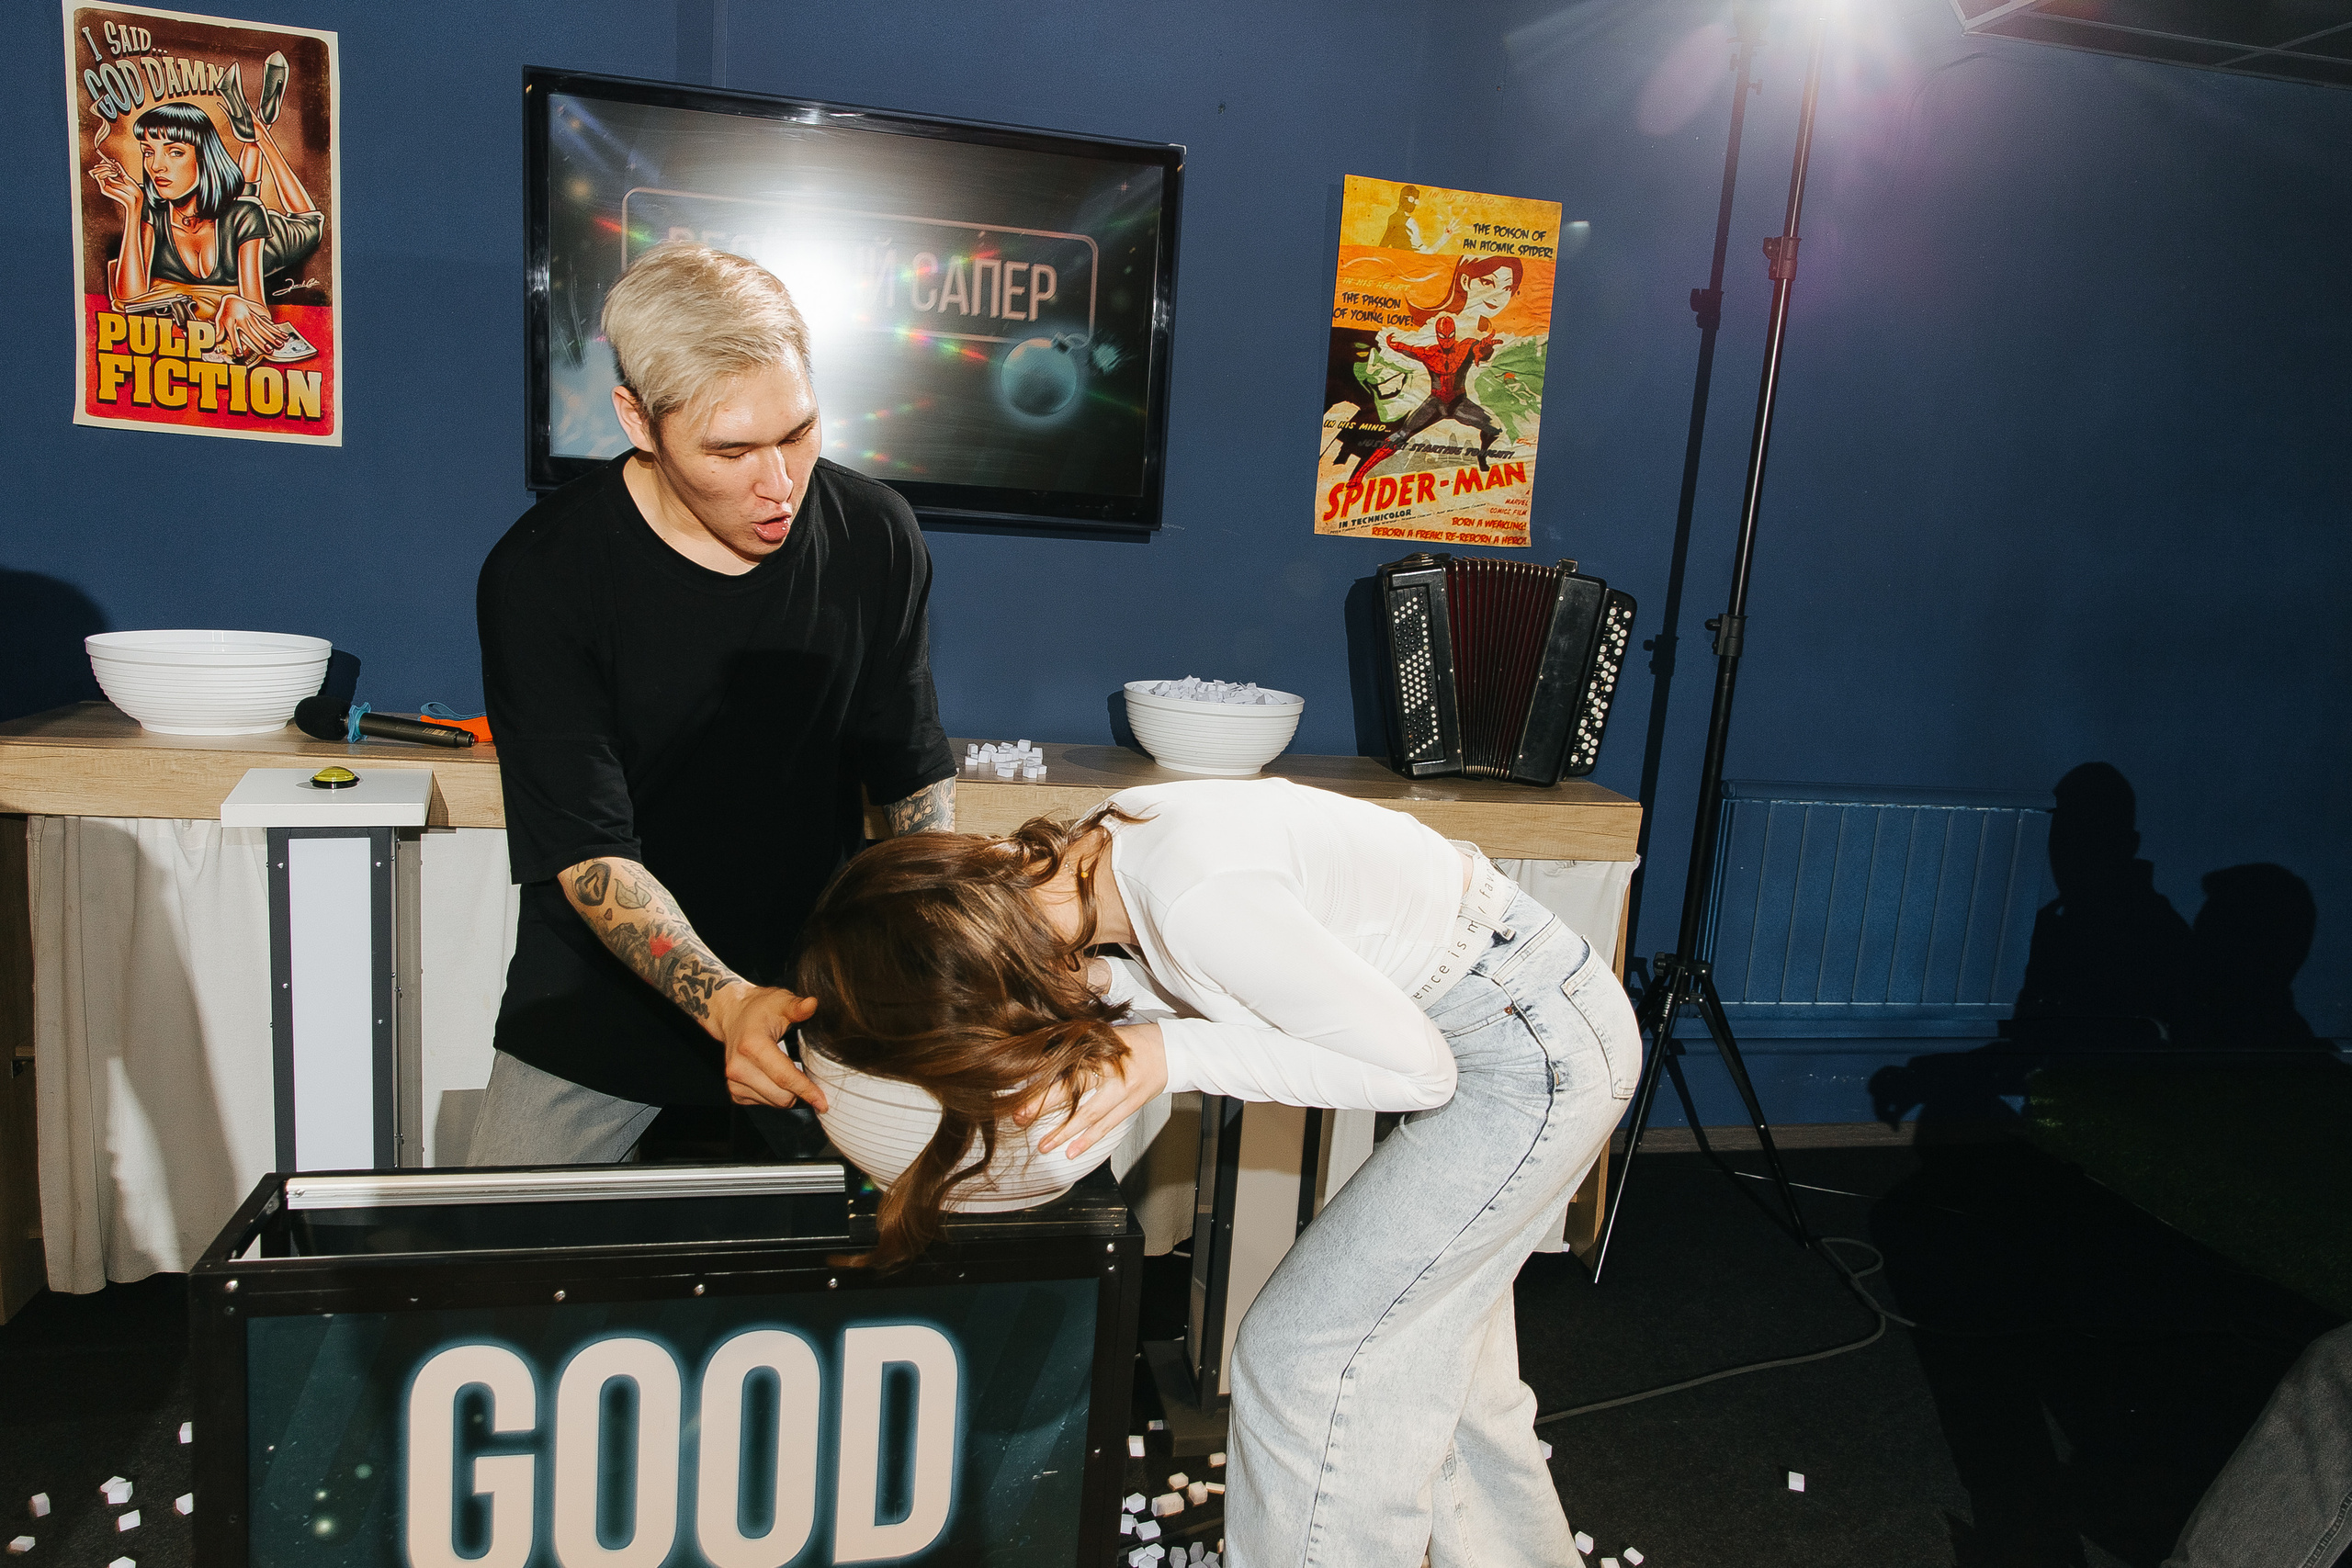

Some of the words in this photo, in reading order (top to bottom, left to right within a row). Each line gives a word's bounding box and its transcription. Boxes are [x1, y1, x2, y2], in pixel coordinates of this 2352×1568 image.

[82, 26, 103, 62] I
[103, 19, 168, 56] SAID...
[83, 58, 145, 119] GOD
[1428, 190, 1440, 198] IN
[1442, 192, 1458, 202] HIS
[1473, 222, 1491, 236] THE
[1493, 225, 1530, 240] POISON
[1531, 230, 1547, 242] OF
[1463, 238, 1477, 250] AN
[1479, 241, 1515, 254] ATOMIC
[1517, 244, 1554, 259] SPIDER!
[910, 251, 1057, 322] САПЕР
[1342, 276, 1354, 285] IN
[1356, 278, 1374, 288] HIS
[1341, 291, 1360, 305] THE
[1362, 294, 1402, 310] PASSION
[1332, 307, 1349, 319] OF
[1350, 309, 1384, 324] YOUNG
[1386, 313, 1415, 327] LOVE!
[97, 311, 216, 359] PULP
[97, 353, 322, 419] FICTION
[1324, 419, 1337, 429] IN
[1338, 421, 1357, 430] HIS
[1408, 442, 1464, 456] STARTING
[1323, 462, 1527, 521] SPIDER-MAN
[1489, 507, 1511, 515] COMICS
[1504, 498, 1529, 506] MARVEL
[1338, 521, 1349, 529] IN
[1351, 509, 1412, 526] TECHNICOLOR
[1452, 516, 1476, 527] BORN
[1476, 518, 1484, 528] A
[1484, 519, 1527, 531] WEAKLING!
[1371, 526, 1406, 537] REBORN
[1407, 528, 1414, 538] A
[1415, 529, 1443, 540] FREAK!
[1444, 532, 1492, 545] RE-REBORN
[1493, 536, 1500, 544] A
[1501, 536, 1527, 546] HERO!
[1447, 940, 1467, 958] is
[407, 1324, 959, 1568] GOOD
